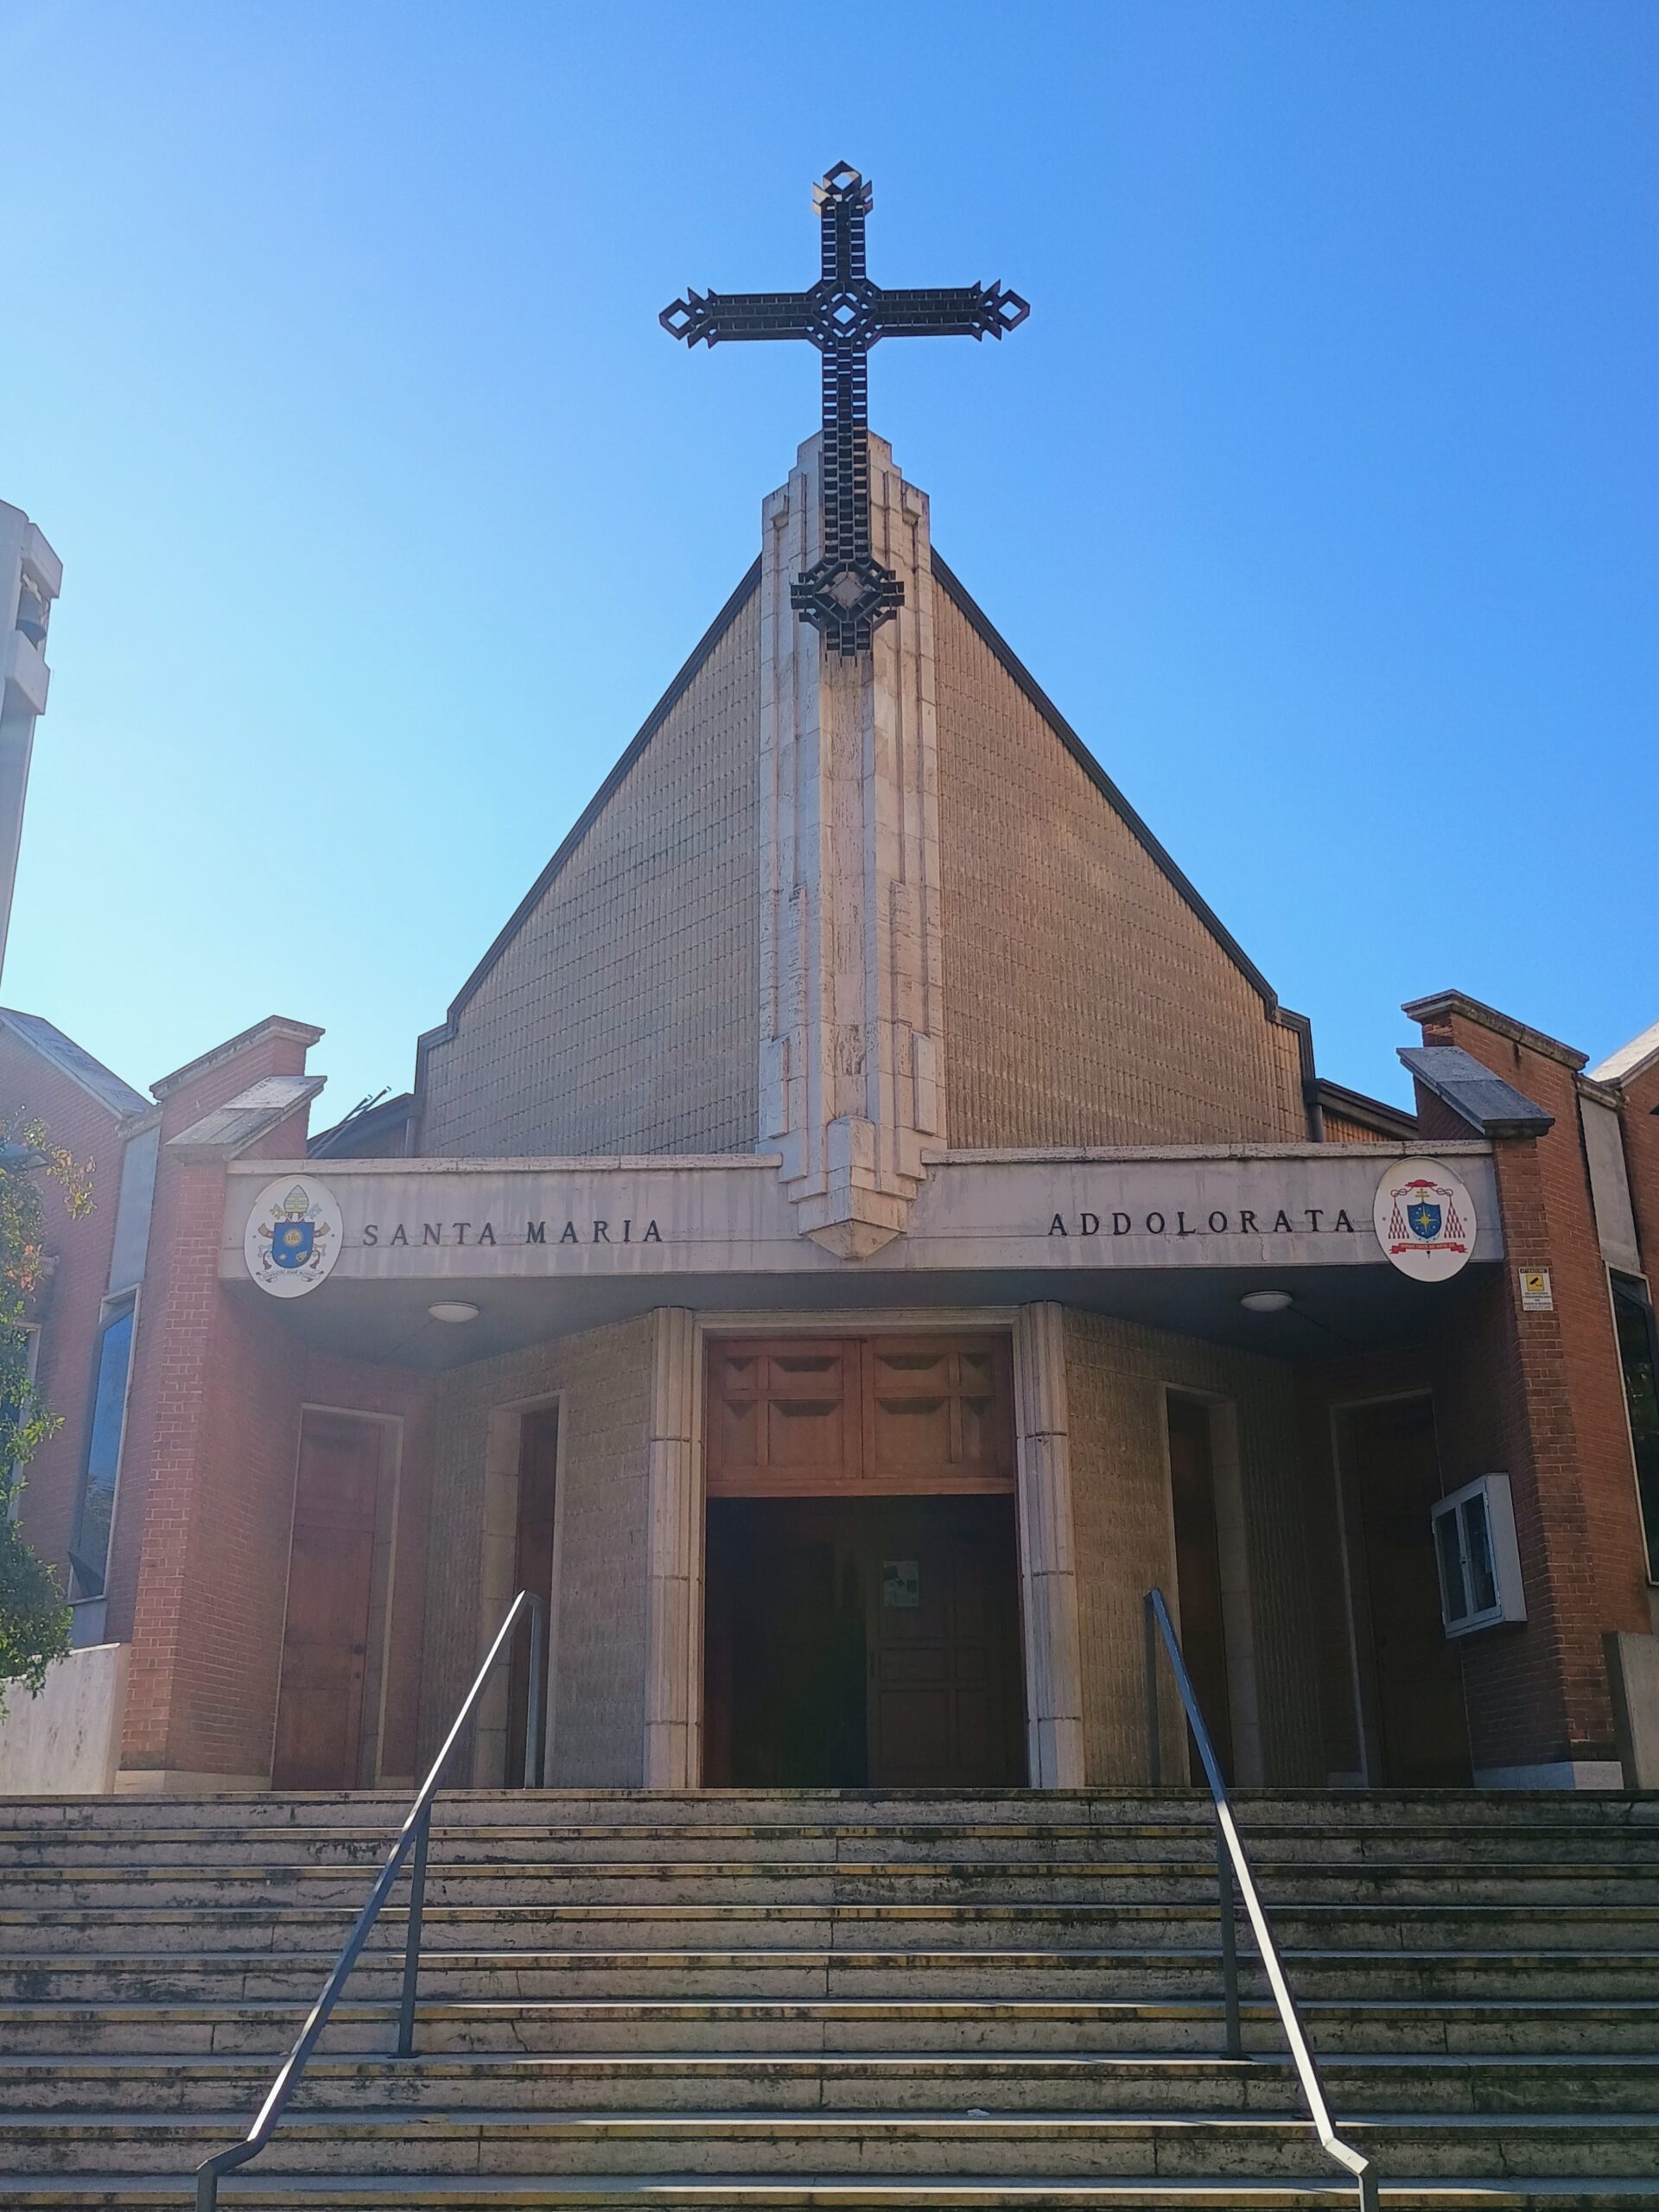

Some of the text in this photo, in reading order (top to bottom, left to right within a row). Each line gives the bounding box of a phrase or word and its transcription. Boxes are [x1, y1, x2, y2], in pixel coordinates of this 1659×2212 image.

[363, 1210, 1354, 1246] SANTA MARIA ADDOLORATA
